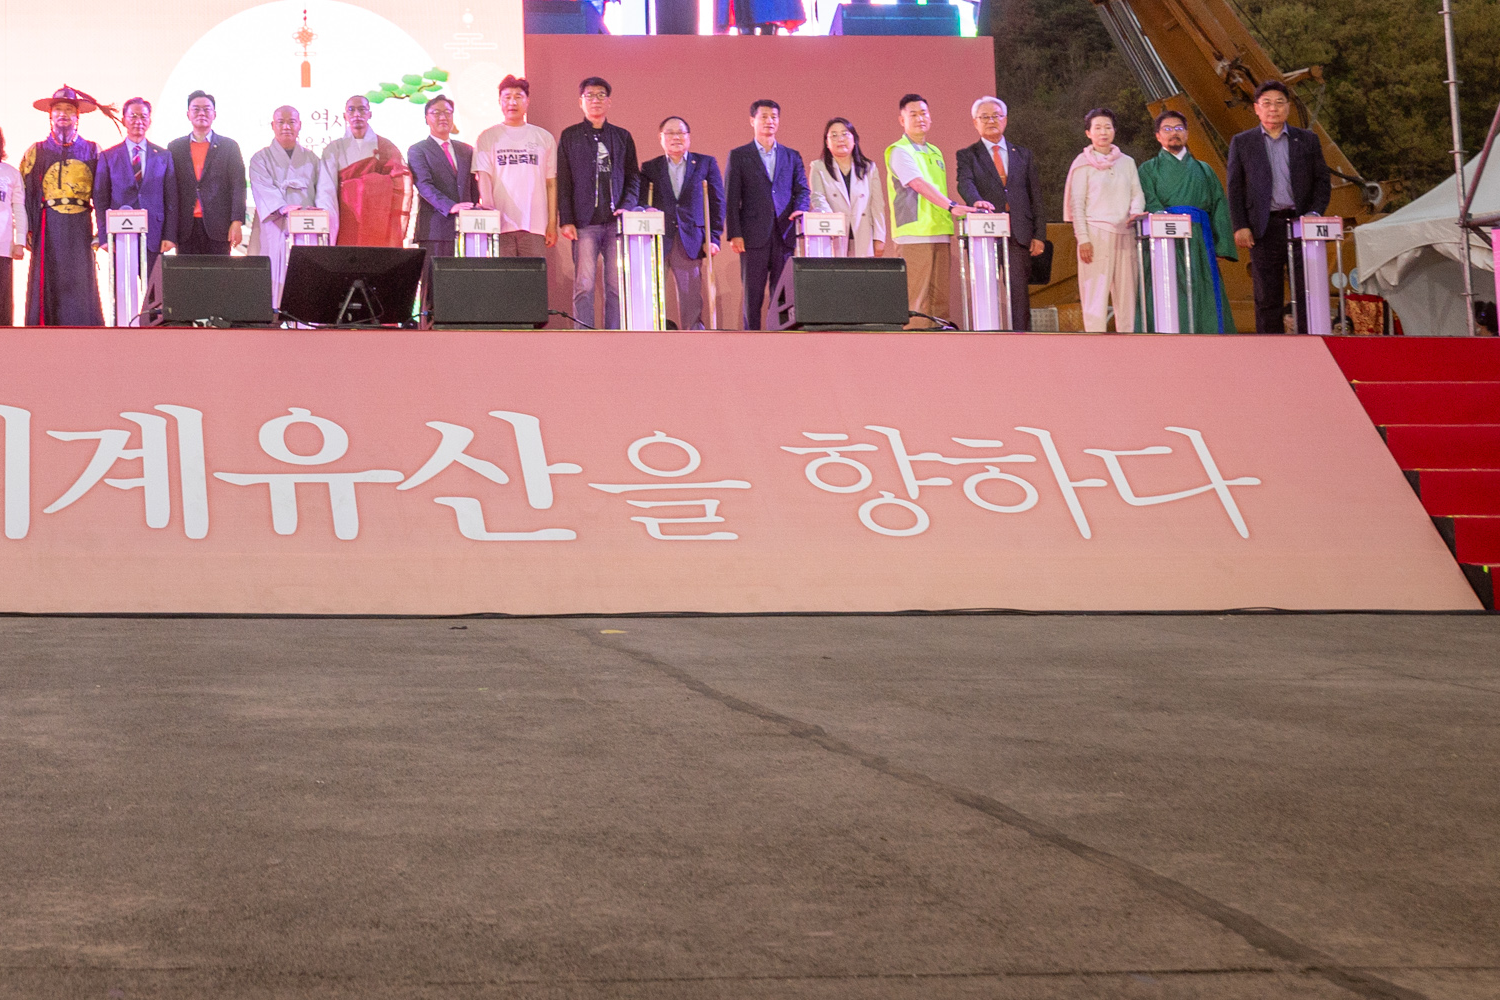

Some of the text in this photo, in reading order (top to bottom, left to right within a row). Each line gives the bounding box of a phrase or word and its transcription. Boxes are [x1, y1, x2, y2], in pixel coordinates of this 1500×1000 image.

[497, 153, 540, 167] 왕실축제
[121, 218, 134, 230] 스
[303, 218, 315, 230] 코
[473, 218, 486, 231] 세
[818, 220, 831, 233] 유
[983, 221, 996, 234] 산
[1165, 222, 1177, 235] 등
[781, 425, 1261, 540] 향하다
